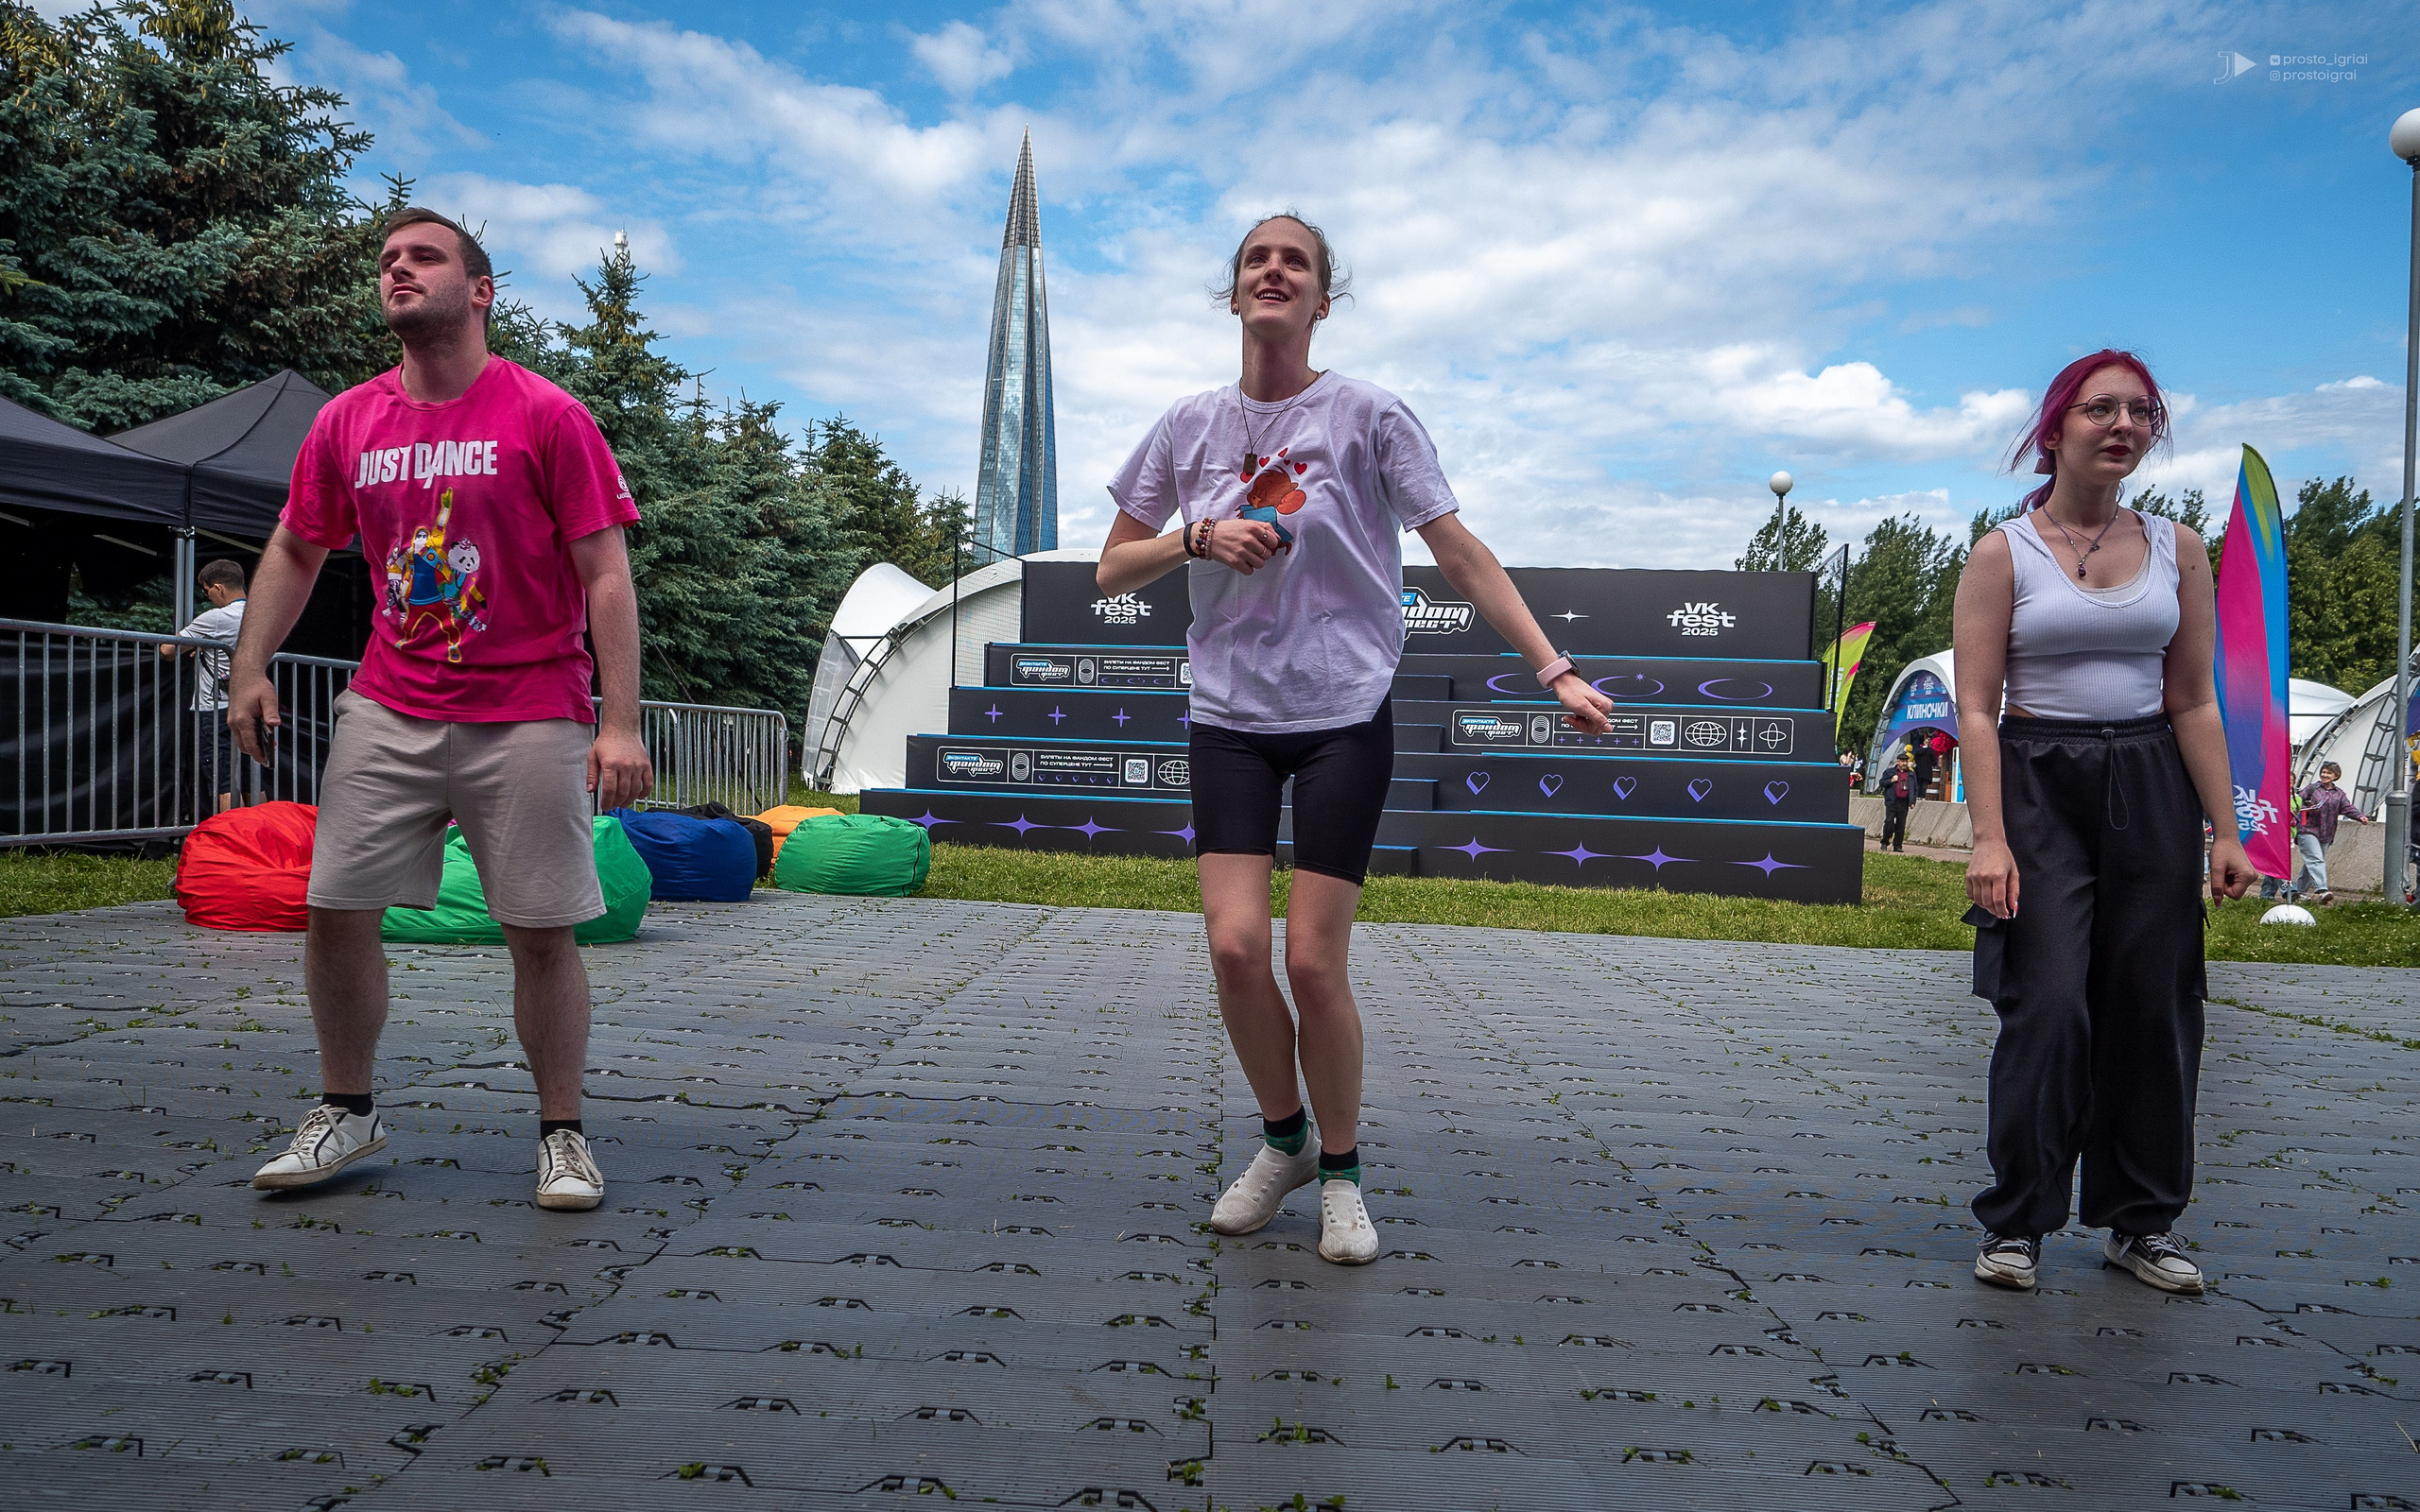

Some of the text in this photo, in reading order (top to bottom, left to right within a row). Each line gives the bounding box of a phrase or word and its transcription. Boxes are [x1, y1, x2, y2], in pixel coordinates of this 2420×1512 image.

[354, 440, 497, 489] JUST DANCE
[1091, 599, 1152, 616] fest
[1685, 603, 1720, 614] VK
[1667, 610, 1737, 627] fest
[1682, 627, 1719, 636] 2025
[1907, 702, 1948, 719] КЛИНОЧКИ
